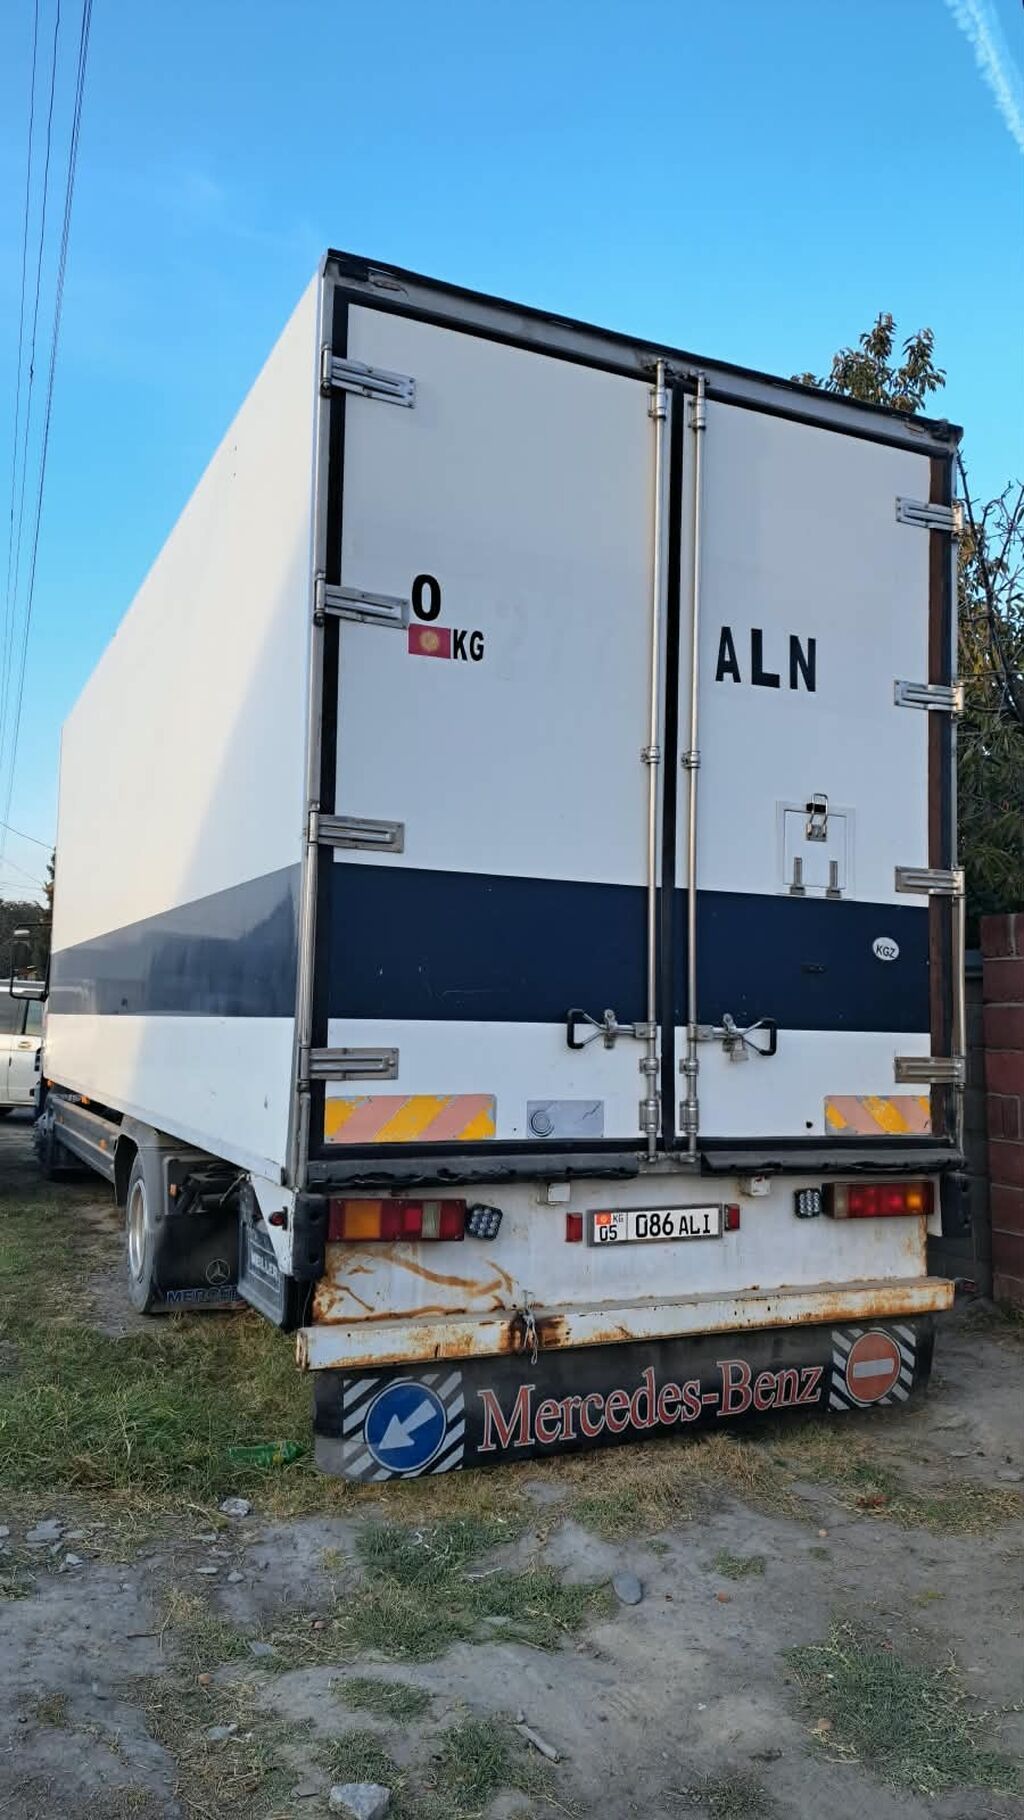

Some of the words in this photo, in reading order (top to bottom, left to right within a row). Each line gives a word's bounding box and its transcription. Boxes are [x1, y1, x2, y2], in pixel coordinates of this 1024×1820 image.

[452, 628, 485, 662] KG
[714, 626, 817, 692] ALN
[875, 944, 896, 959] KGZ
[612, 1213, 624, 1224] KG
[635, 1212, 674, 1238] 086
[678, 1214, 711, 1236] ALI
[599, 1225, 618, 1242] 05
[477, 1359, 824, 1452] Mercedes-Benz
